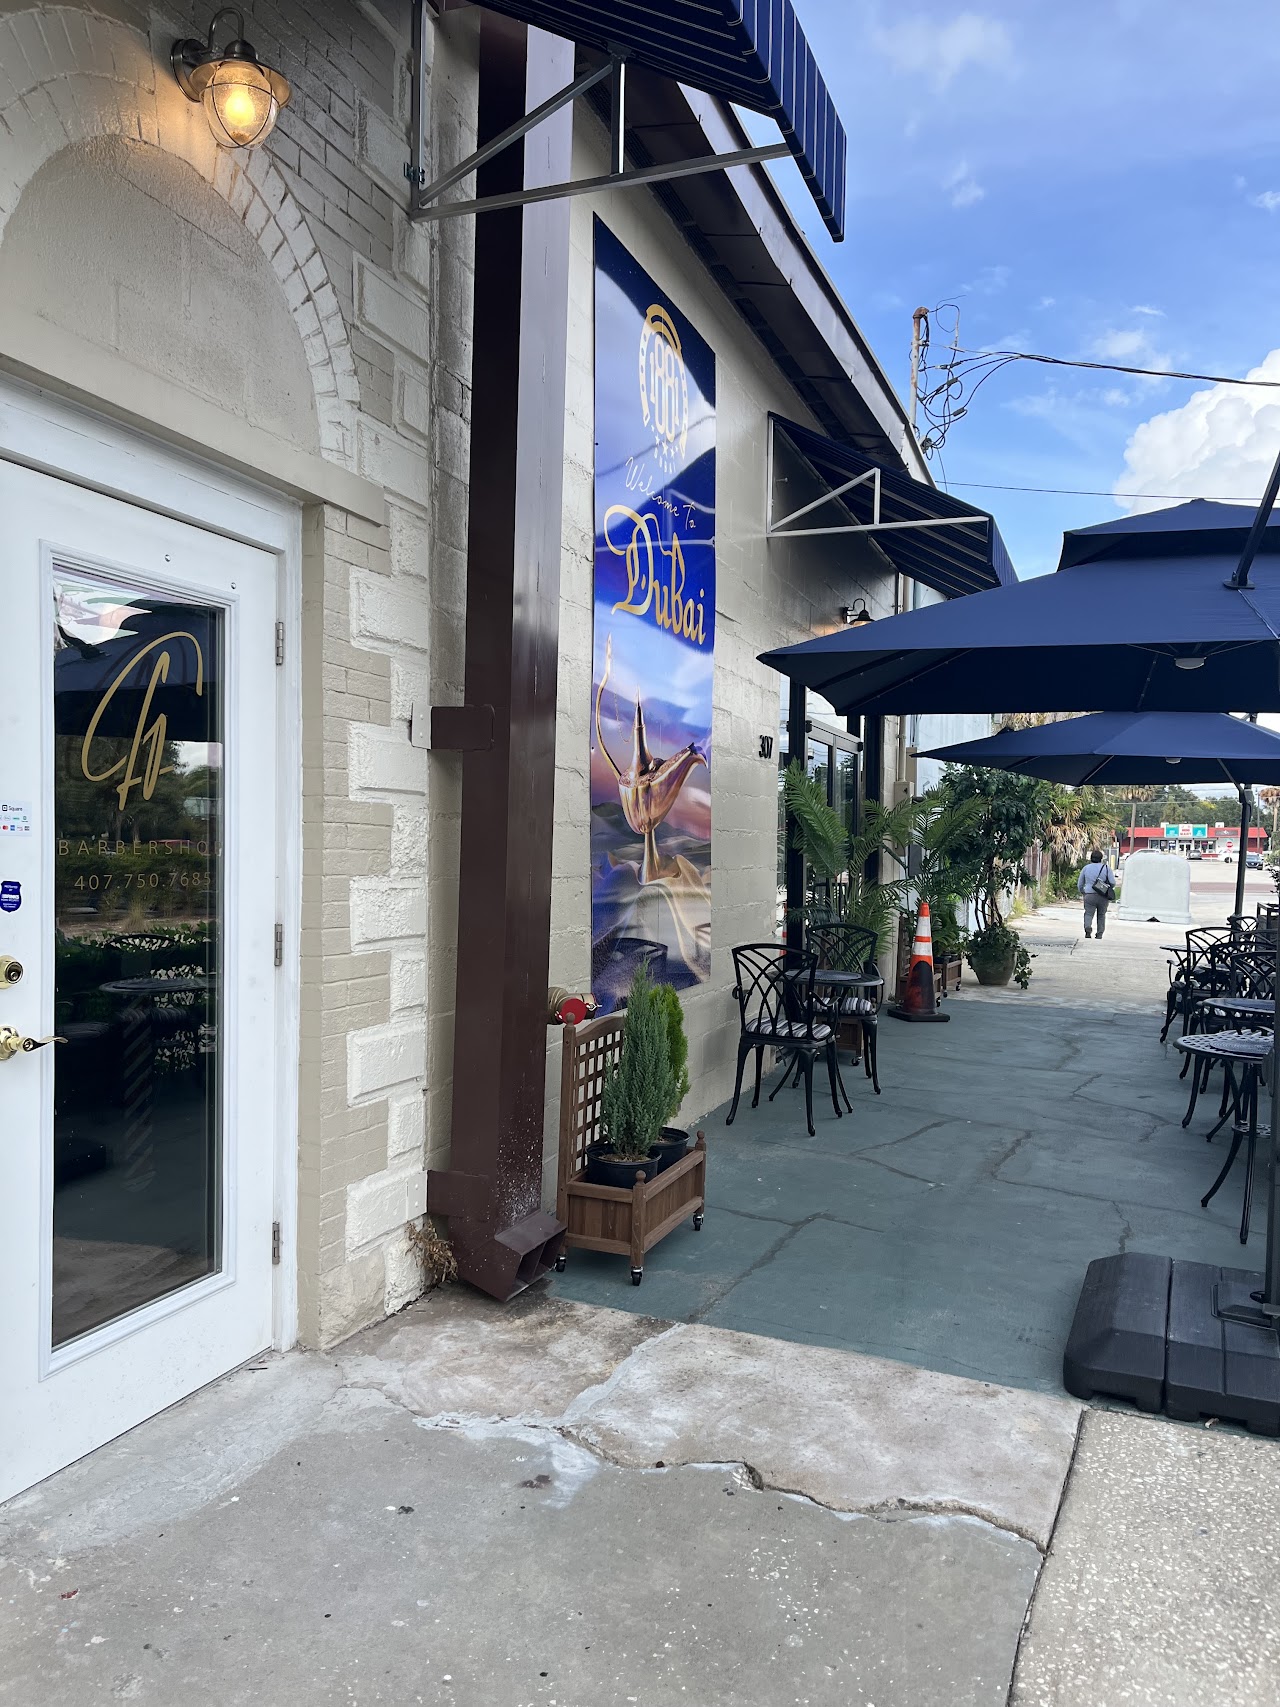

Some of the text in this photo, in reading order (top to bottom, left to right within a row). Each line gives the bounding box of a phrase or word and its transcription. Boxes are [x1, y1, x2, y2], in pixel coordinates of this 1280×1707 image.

[650, 334, 679, 443] 1881
[625, 456, 680, 516] Welcome
[603, 504, 706, 644] Dubai
[758, 734, 773, 759] 307
[74, 872, 211, 890] 407.750.7685
